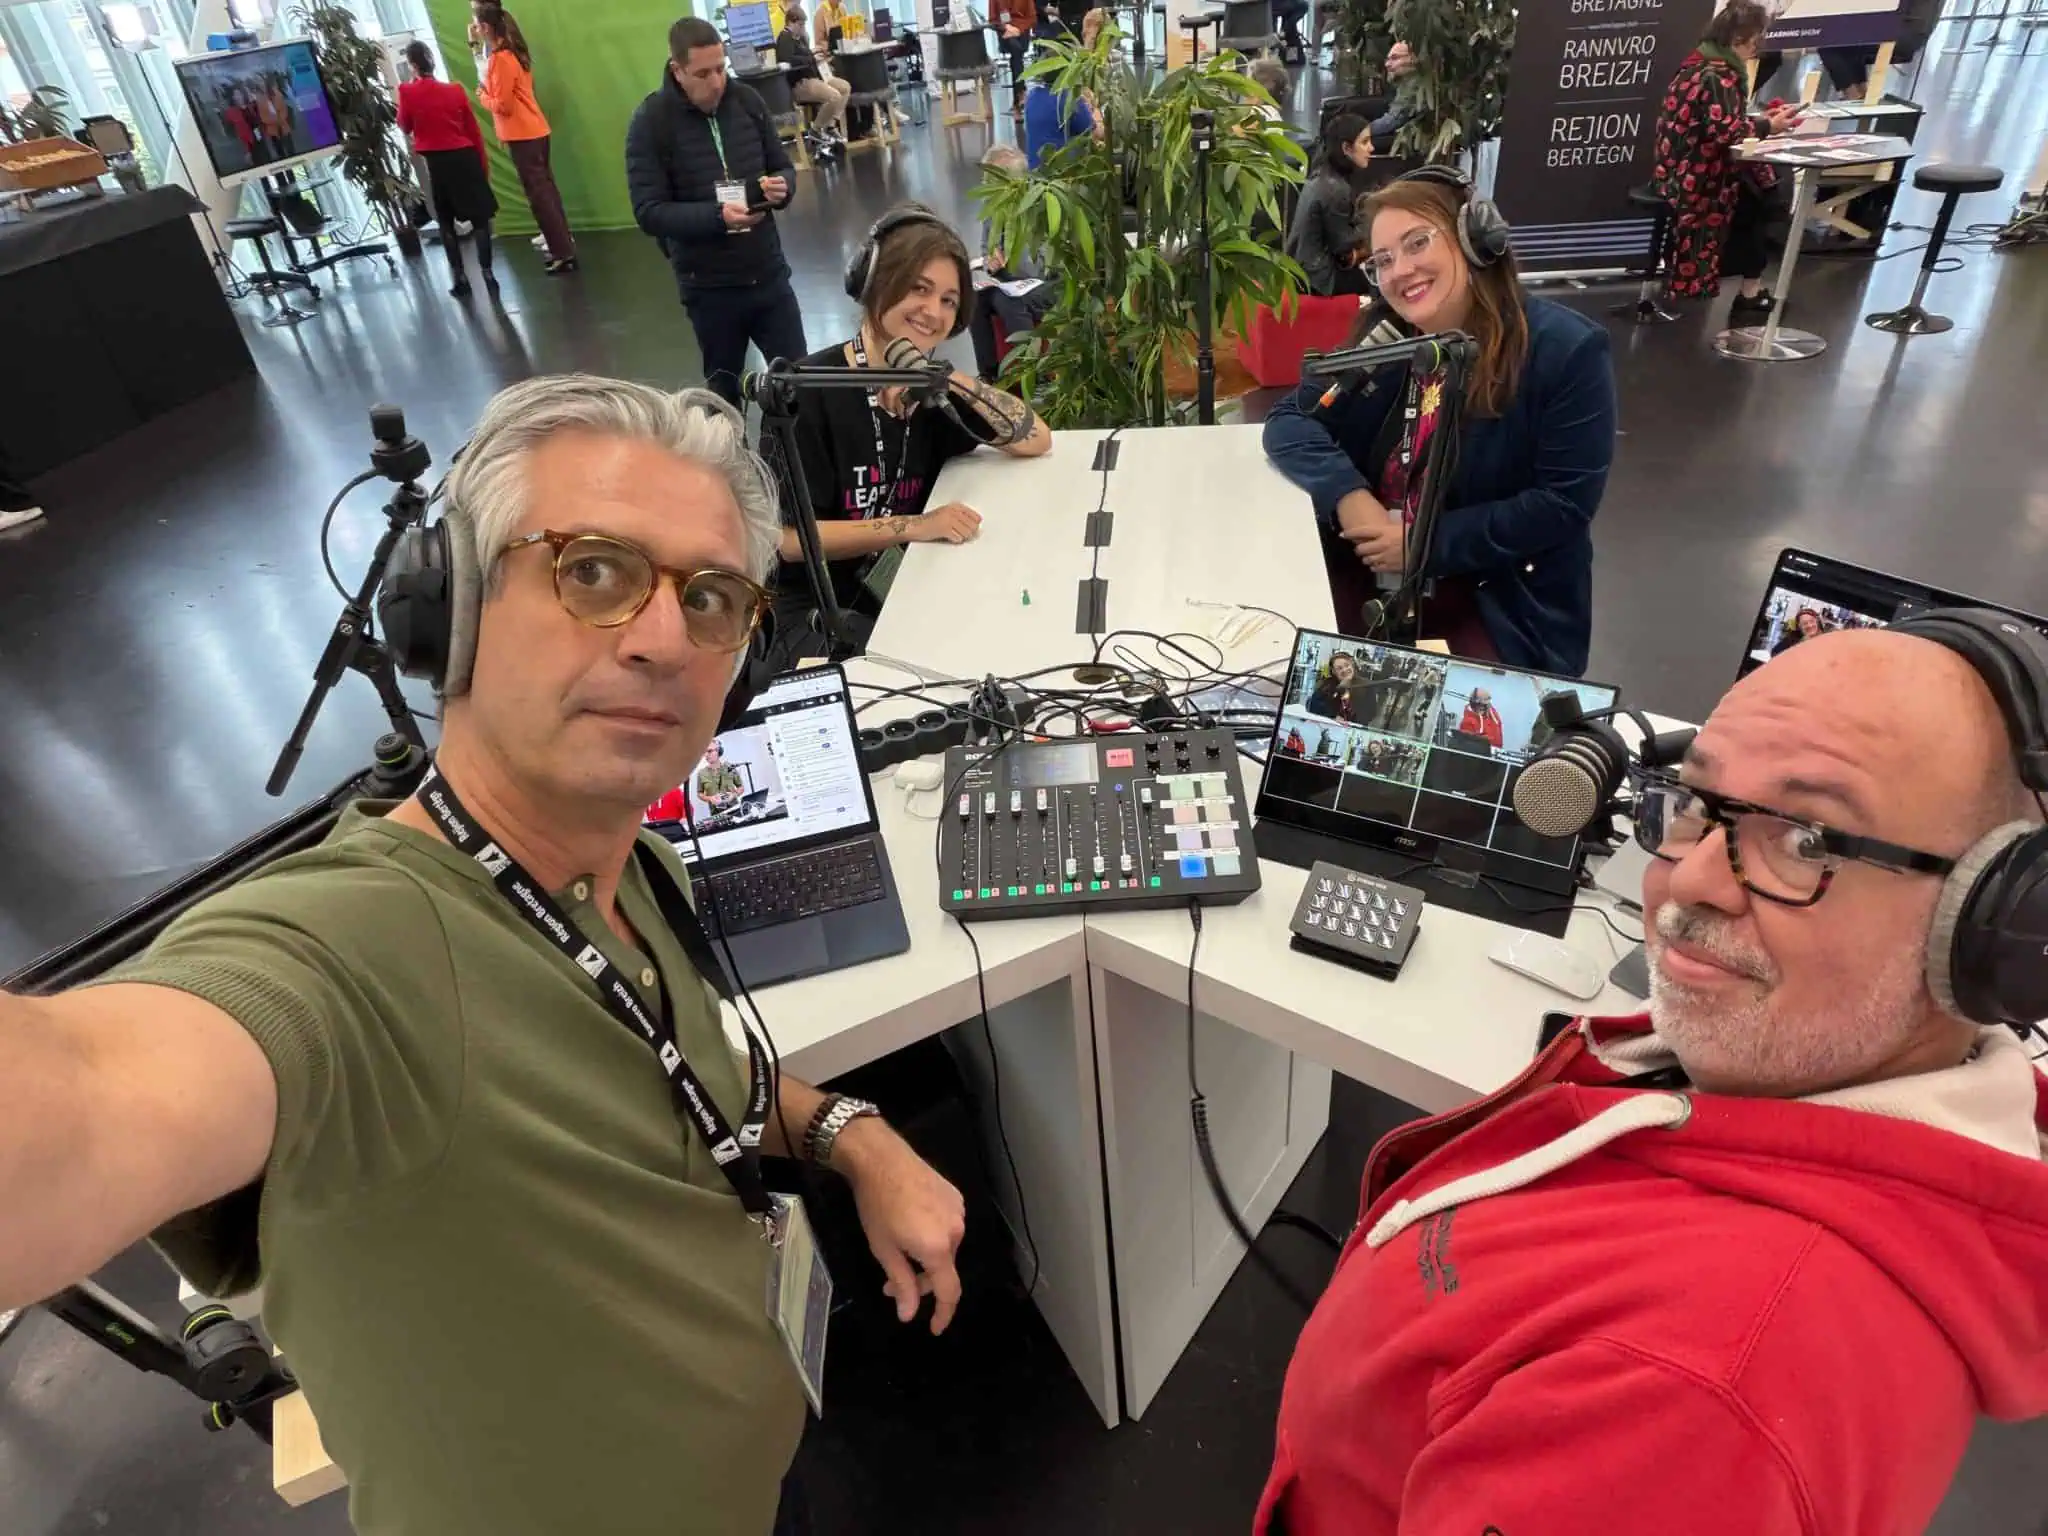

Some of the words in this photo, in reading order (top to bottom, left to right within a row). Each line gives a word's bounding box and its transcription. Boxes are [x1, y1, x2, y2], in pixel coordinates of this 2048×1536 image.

[1563, 35, 1656, 59] RANNVRO
[1559, 60, 1652, 89] BREIZH
[1551, 113, 1641, 143] REJION
[512, 882, 545, 918] Bretagne
[544, 912, 570, 943] Région
